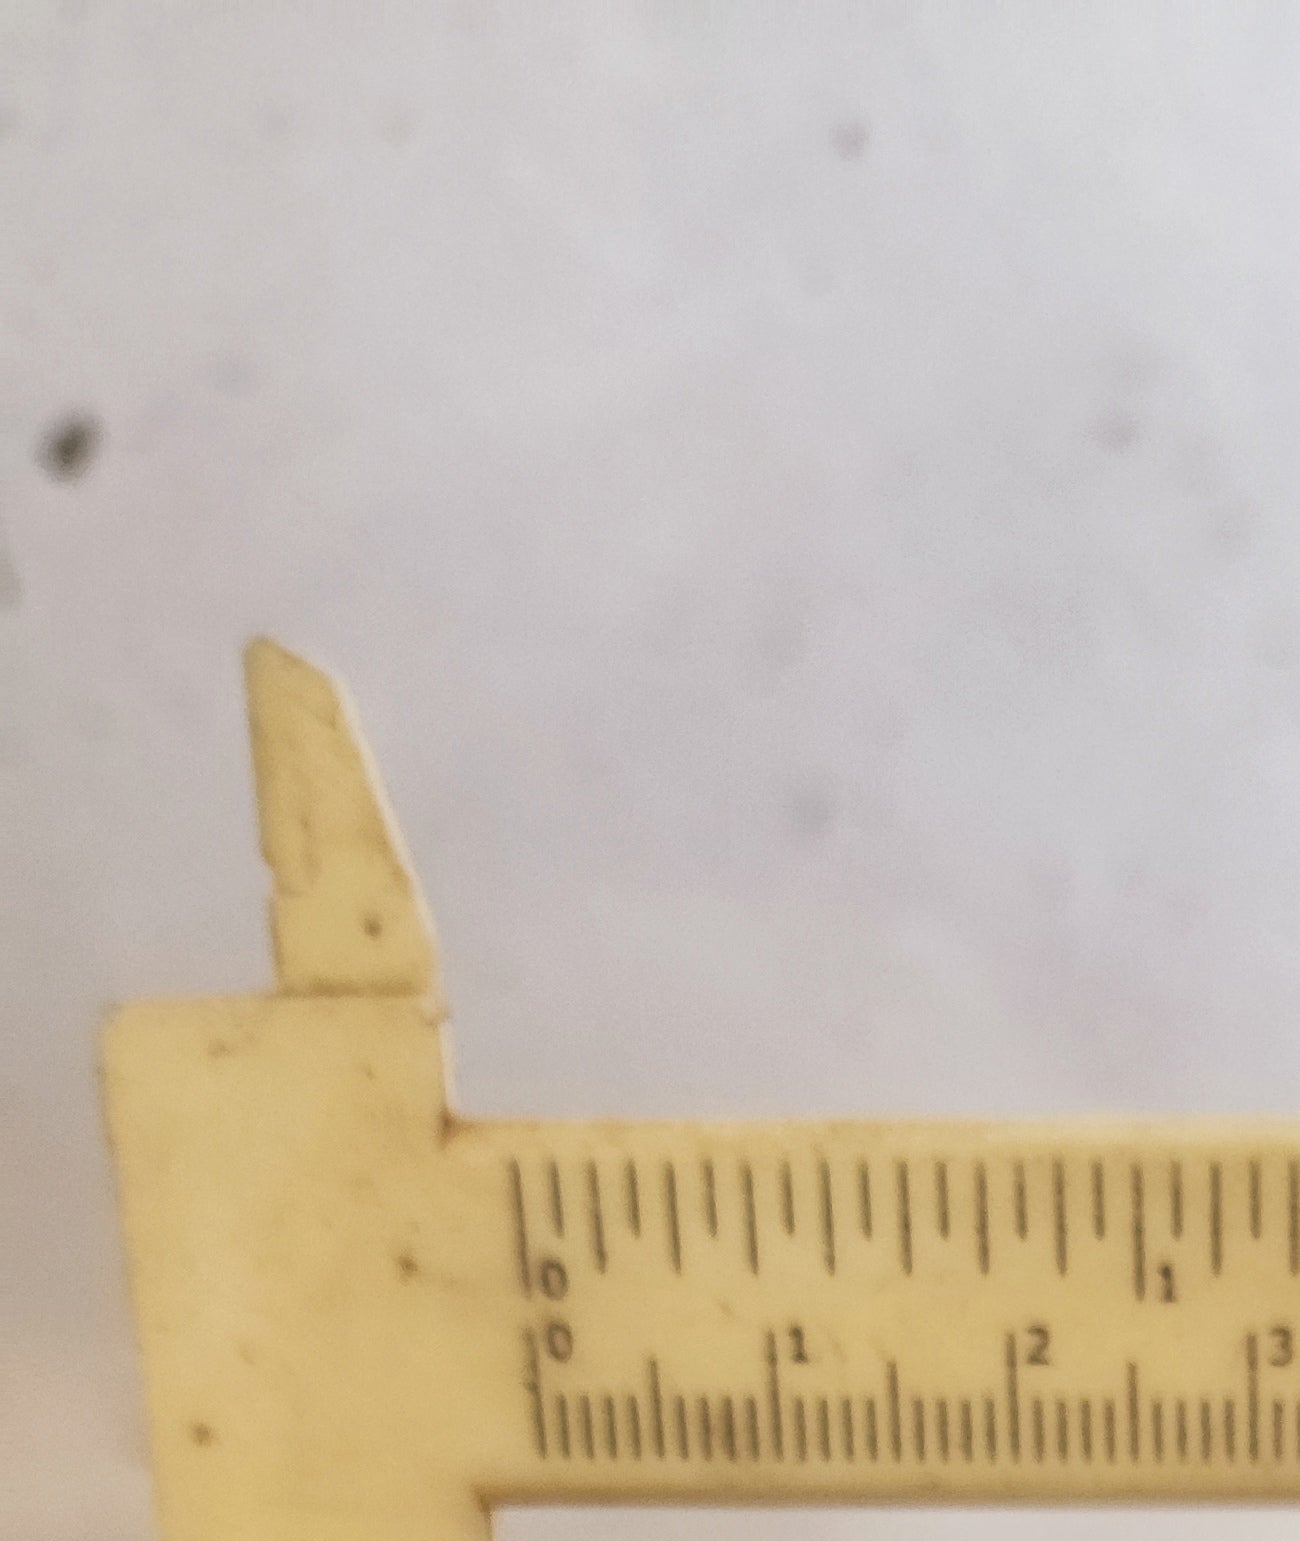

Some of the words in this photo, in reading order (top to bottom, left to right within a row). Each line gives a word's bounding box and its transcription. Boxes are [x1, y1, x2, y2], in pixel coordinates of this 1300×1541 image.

[540, 1259, 568, 1301] 0
[1157, 1265, 1178, 1303] 1
[545, 1321, 573, 1362] 0
[788, 1327, 810, 1364] 1
[1024, 1327, 1052, 1366] 2
[1269, 1328, 1295, 1366] 3
